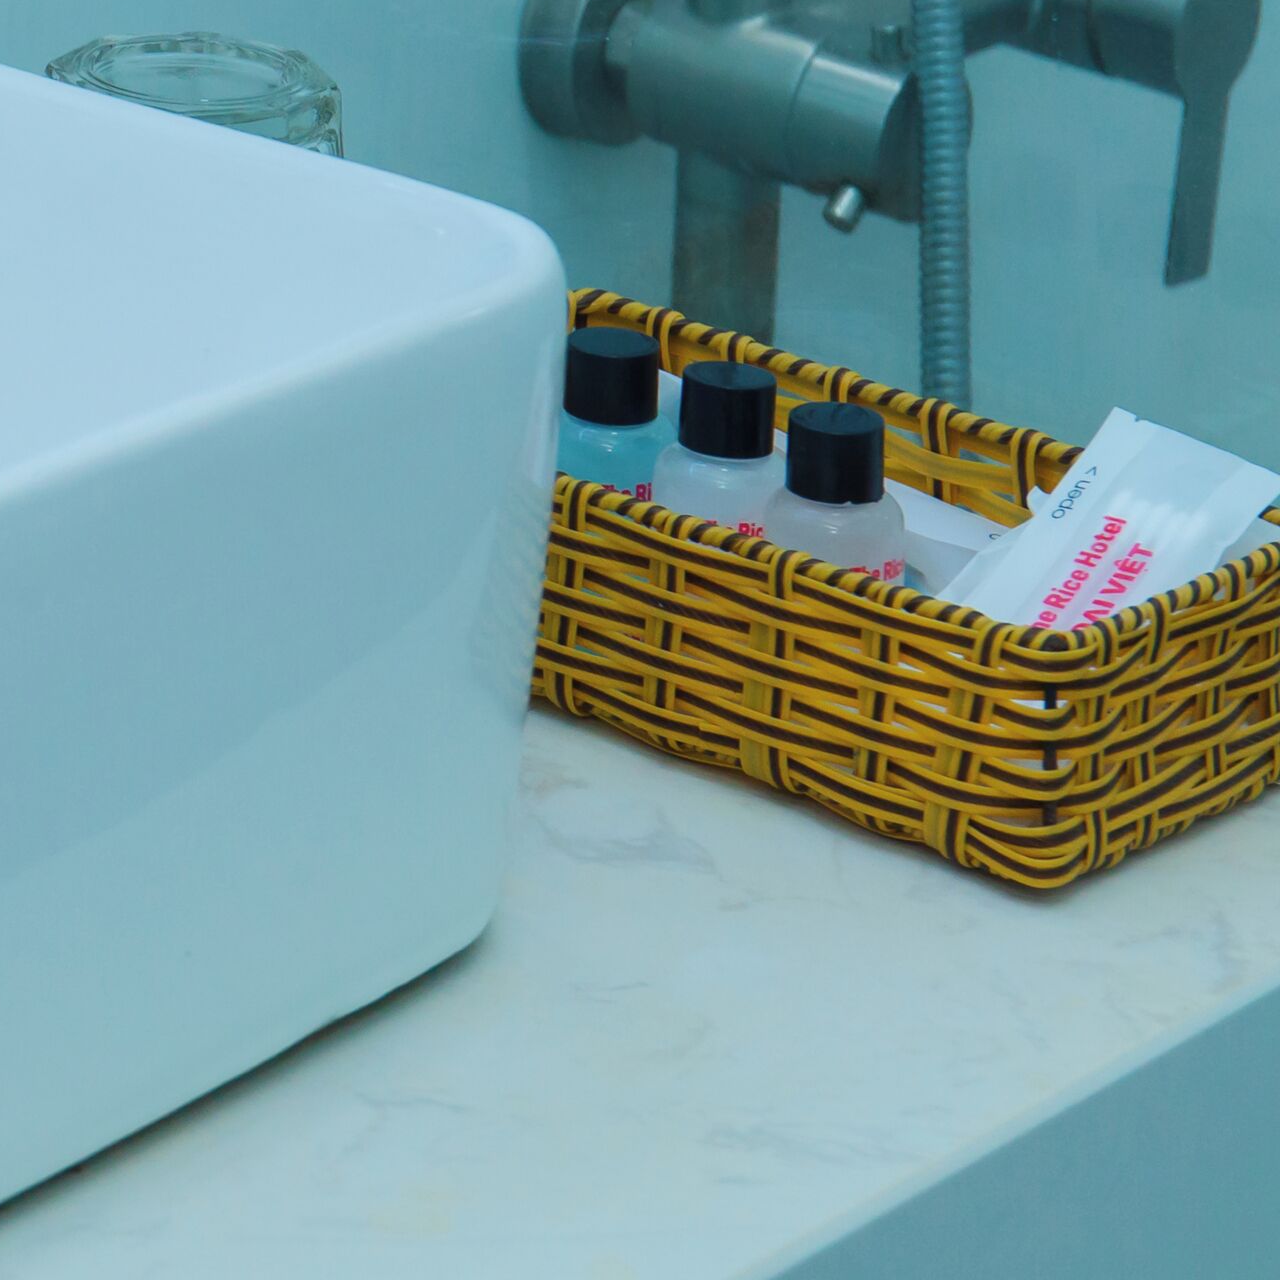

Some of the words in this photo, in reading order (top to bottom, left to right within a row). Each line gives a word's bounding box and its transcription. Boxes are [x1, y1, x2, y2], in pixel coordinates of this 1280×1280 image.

[1051, 480, 1091, 519] open
[1043, 569, 1090, 609] Rice
[1074, 515, 1127, 568] Hotel
[1100, 543, 1154, 595] VIỆT
